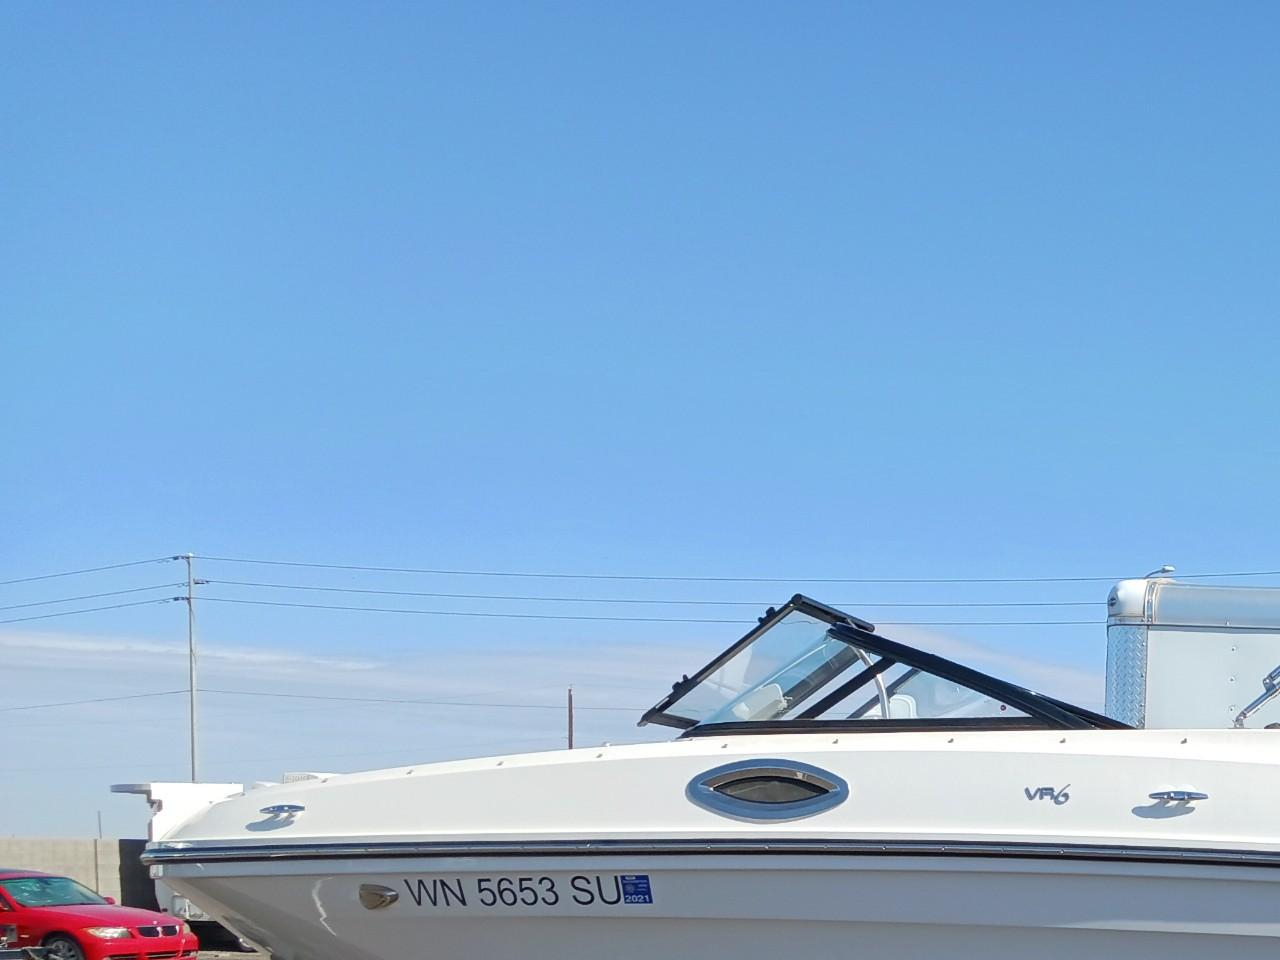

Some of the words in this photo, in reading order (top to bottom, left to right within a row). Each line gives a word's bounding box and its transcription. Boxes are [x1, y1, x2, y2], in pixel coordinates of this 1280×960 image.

[1024, 783, 1071, 806] VR6
[403, 878, 468, 907] WN
[477, 876, 560, 907] 5653
[570, 874, 622, 905] SU
[625, 894, 651, 903] 2021
